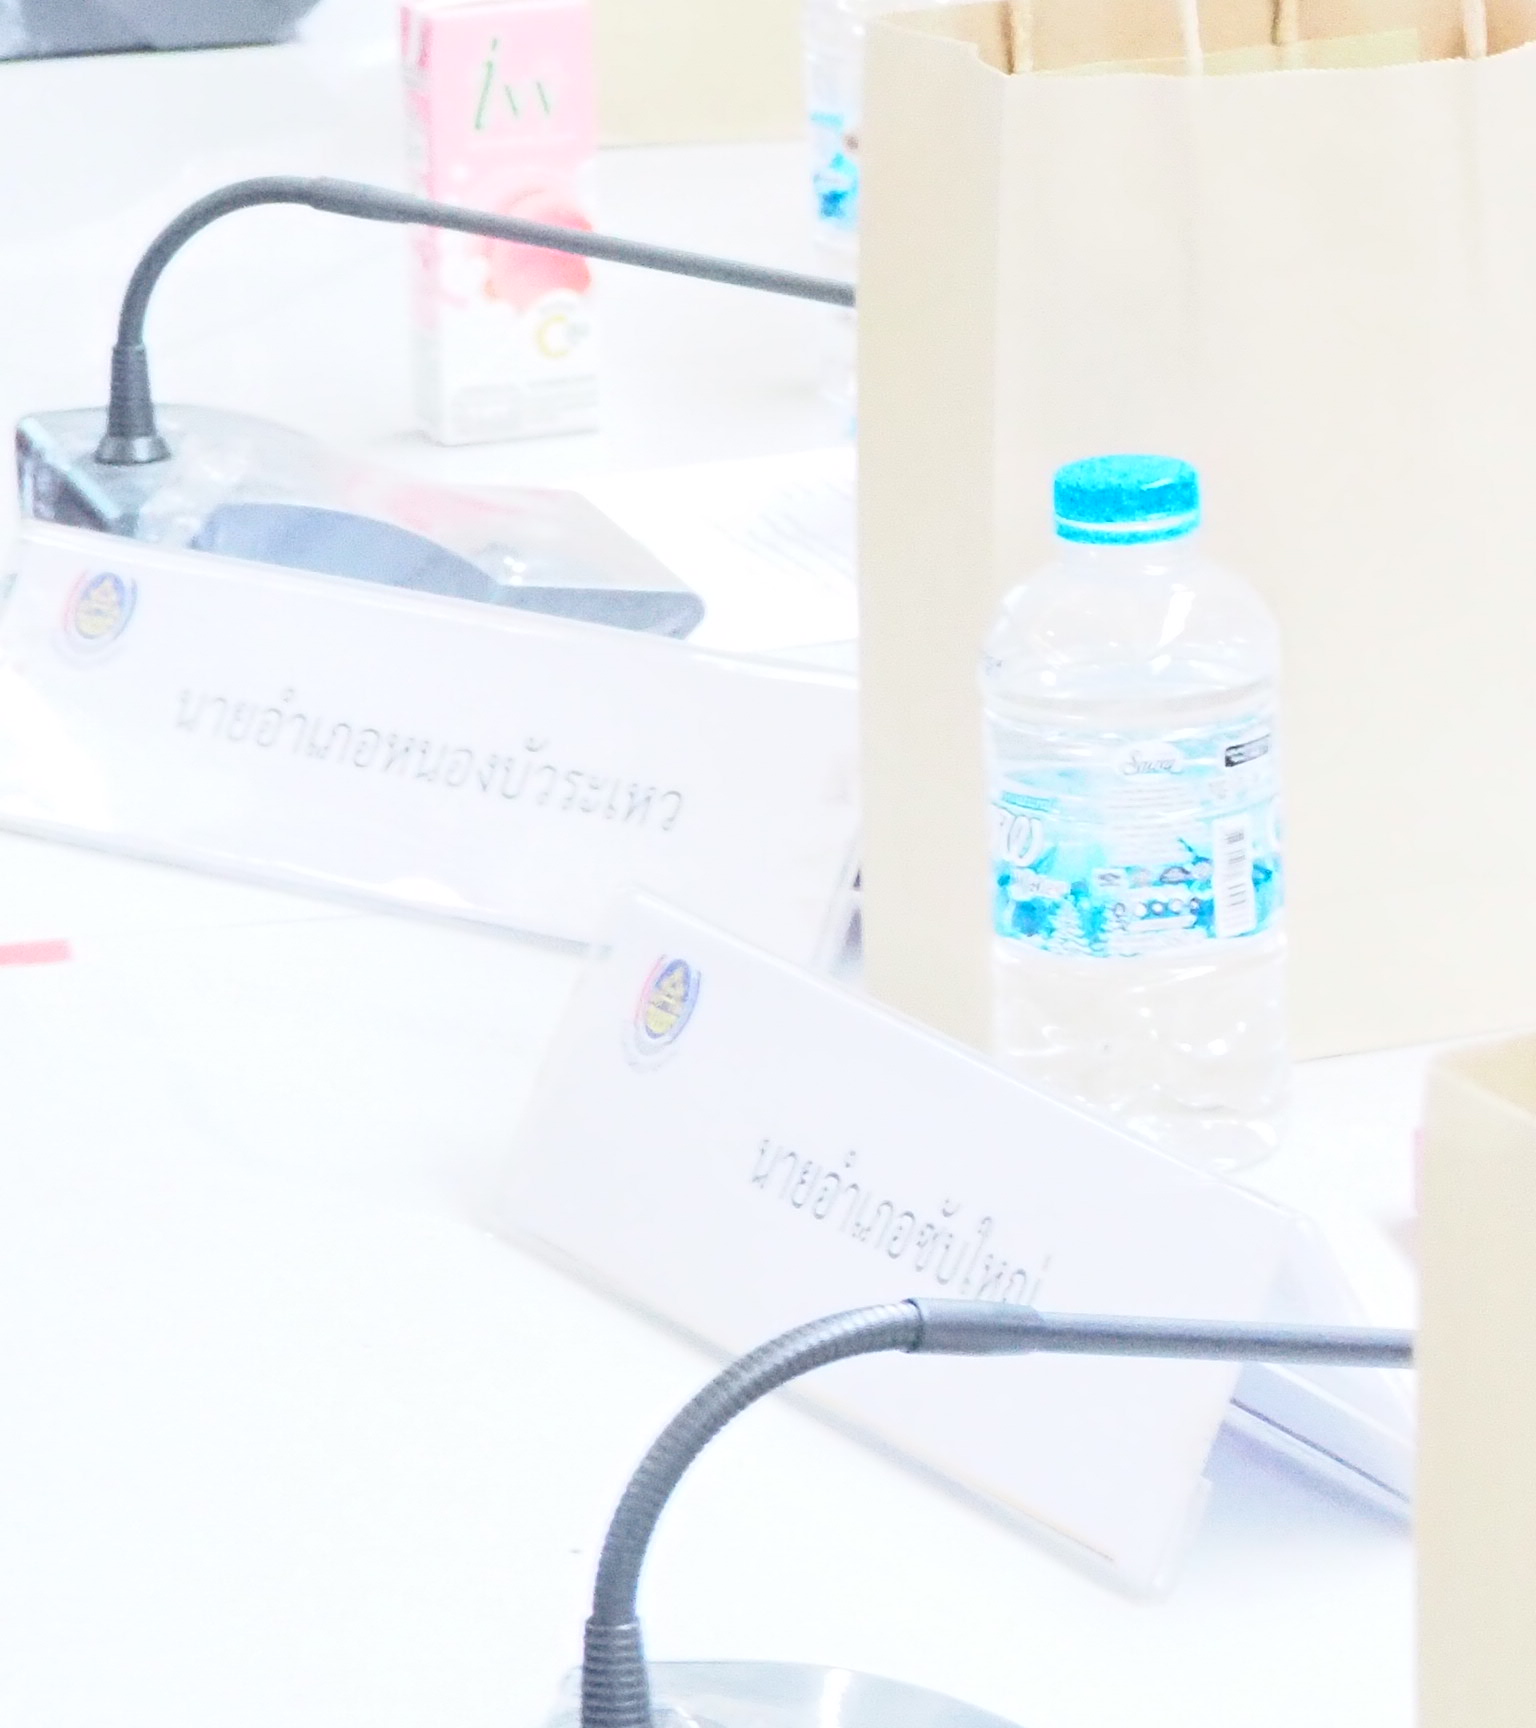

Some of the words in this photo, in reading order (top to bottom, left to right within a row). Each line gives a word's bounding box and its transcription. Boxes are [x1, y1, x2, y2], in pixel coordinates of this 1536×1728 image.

[174, 685, 685, 832] นายอำเภอหนองบัวระเหว
